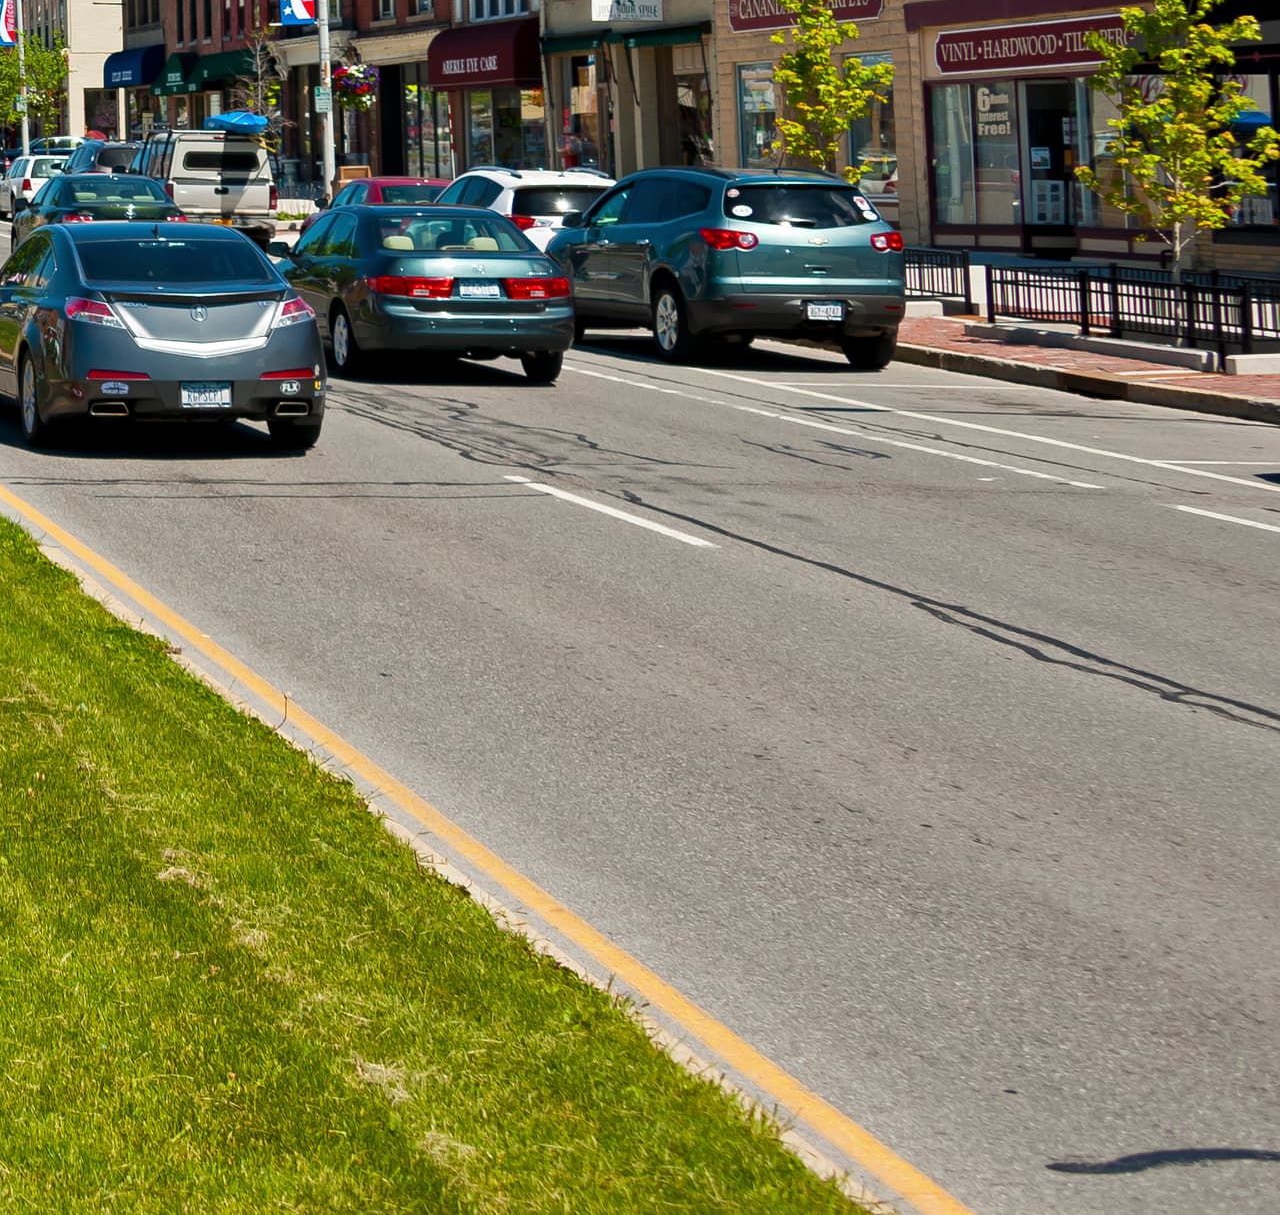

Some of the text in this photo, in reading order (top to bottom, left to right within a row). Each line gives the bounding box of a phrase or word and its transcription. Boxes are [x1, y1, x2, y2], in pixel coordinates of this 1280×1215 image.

[940, 41, 977, 62] VINYL
[983, 34, 1057, 59] HARDWOOD
[442, 55, 498, 75] ABERLE EYE CARE
[977, 87, 991, 112] 6
[978, 111, 1009, 122] Interest
[978, 121, 1011, 136] Free!
[281, 382, 299, 392] FLX
